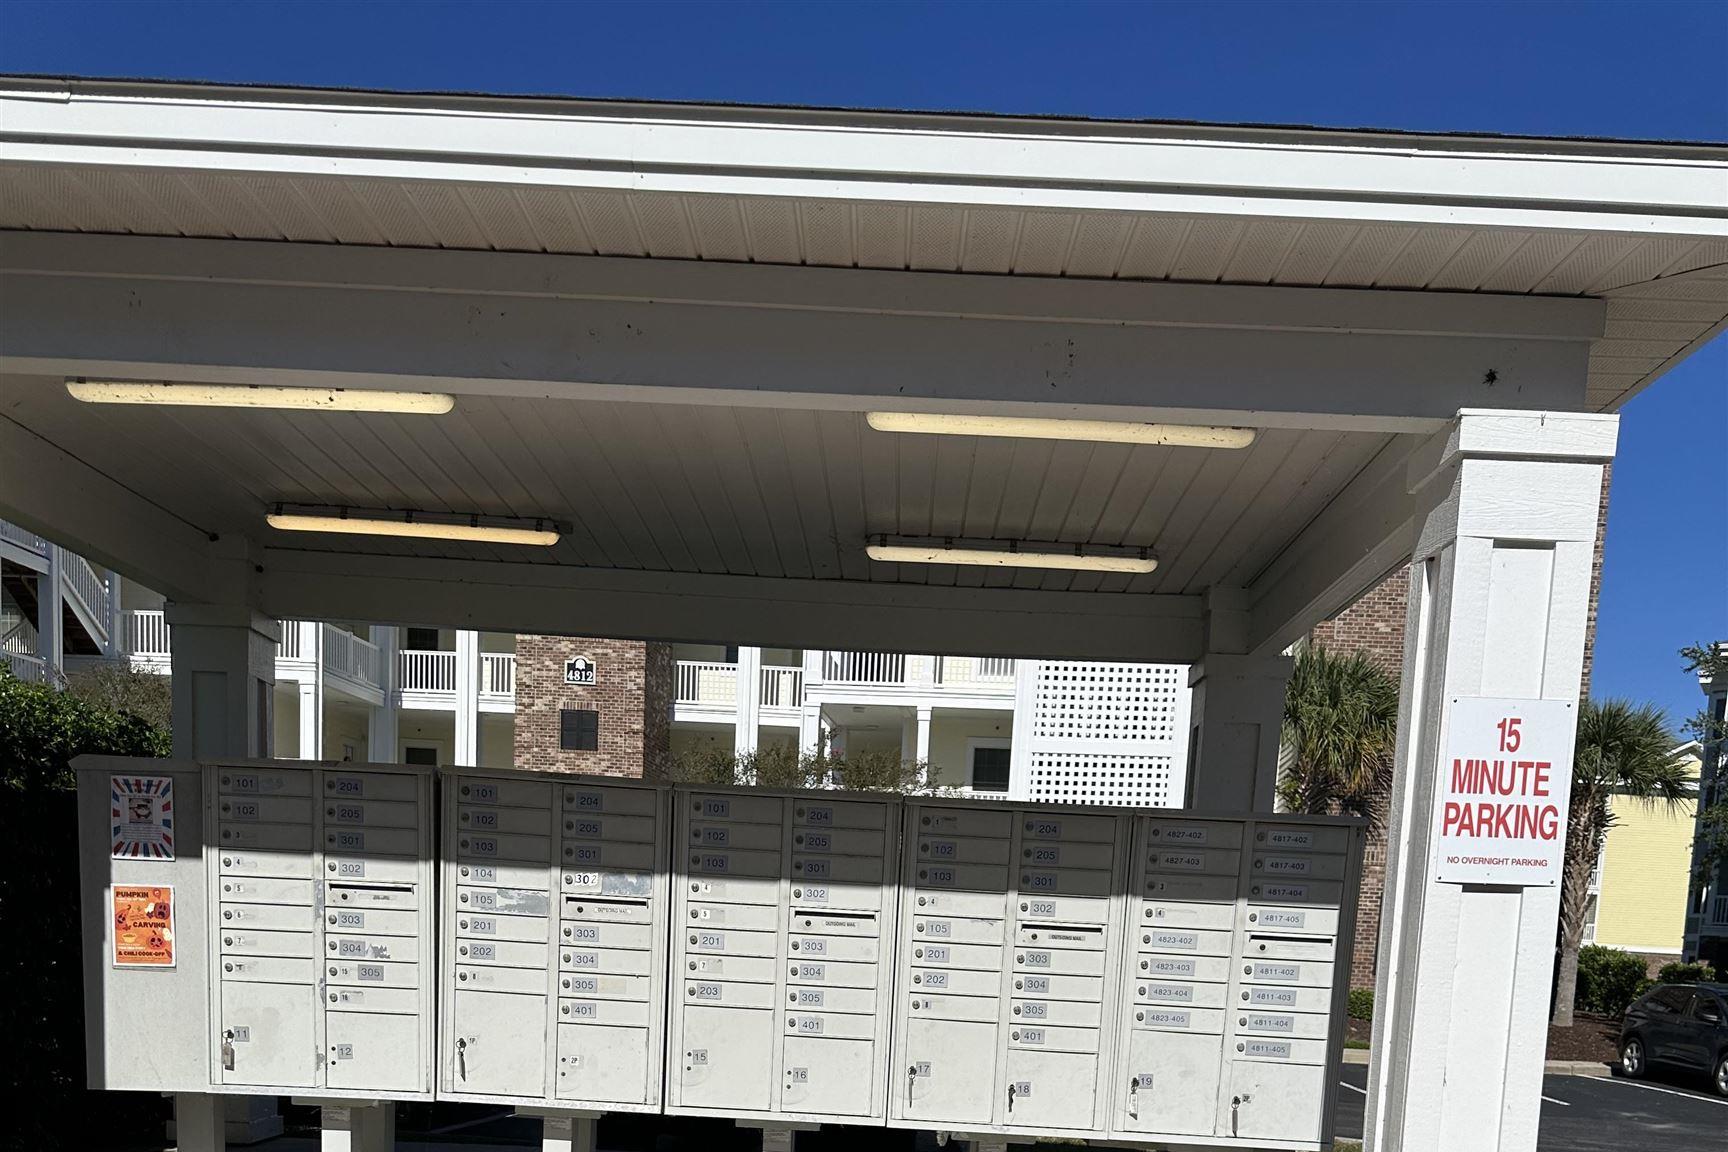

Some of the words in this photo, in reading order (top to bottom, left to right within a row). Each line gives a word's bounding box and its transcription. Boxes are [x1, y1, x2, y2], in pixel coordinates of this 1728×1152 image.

[568, 670, 593, 681] 4812
[1497, 718, 1522, 752] 15
[1451, 759, 1551, 796] MINUTE
[236, 778, 253, 788] 101
[340, 782, 359, 792] 204
[476, 789, 493, 797] 101
[580, 796, 598, 806] 204
[237, 806, 255, 816] 102
[708, 804, 725, 813] 101
[340, 809, 359, 818] 205
[810, 811, 828, 820] 204
[475, 816, 494, 824] 102
[1442, 802, 1558, 840] PARKING
[579, 824, 598, 832] 205
[1039, 825, 1057, 834] 204
[707, 832, 725, 840] 102
[1167, 831, 1201, 839] 4827-402
[1272, 835, 1308, 844] 4817-402
[342, 836, 359, 845] 301
[808, 838, 827, 847] 205
[475, 842, 494, 851] 103
[935, 846, 952, 854] 102
[578, 849, 597, 859] 301
[1037, 851, 1055, 860] 205
[706, 858, 724, 867] 103
[1165, 857, 1200, 866] 4827-403
[1270, 862, 1305, 870] 4817-403
[1447, 856, 1460, 864] NO
[1462, 857, 1509, 865] OVERNIGHT
[1511, 859, 1548, 867] PARKING
[342, 864, 360, 873] 302
[807, 864, 825, 872] 301
[475, 869, 492, 878] 104
[934, 872, 952, 881] 103
[575, 874, 597, 885] 302
[1035, 877, 1052, 886] 301
[807, 889, 825, 898] 302
[1267, 888, 1302, 896] 4817-404
[475, 896, 492, 904] 105
[1034, 904, 1052, 912] 302
[342, 915, 360, 924] 303
[1264, 914, 1299, 923] 4817-405
[473, 922, 491, 930] 201
[930, 925, 947, 933] 105
[576, 929, 595, 938] 303
[702, 936, 720, 945] 201
[1158, 936, 1192, 944] 4823-402
[342, 943, 361, 952] 304
[805, 942, 823, 950] 303
[473, 947, 491, 956] 202
[928, 950, 945, 958] 201
[576, 956, 594, 964] 304
[1029, 955, 1047, 963] 303
[803, 967, 821, 976] 304
[1156, 963, 1190, 971] 4823-403
[361, 968, 380, 976] 305
[1260, 968, 1294, 976] 4811-402
[927, 976, 944, 984] 202
[1027, 980, 1046, 989] 304
[575, 981, 594, 990] 305
[700, 987, 718, 995] 203
[1154, 989, 1187, 997] 4823-404
[802, 994, 820, 1002] 305
[1256, 994, 1291, 1002] 4811-403
[574, 1006, 592, 1015] 401
[1025, 1006, 1043, 1014] 305
[1151, 1015, 1185, 1023] 4823-405
[1254, 1019, 1288, 1027] 4811-404
[803, 1021, 820, 1030] 401
[236, 1029, 248, 1039] 11
[1024, 1032, 1041, 1041] 401
[340, 1047, 351, 1056] 12
[1251, 1045, 1286, 1053] 4811-405
[695, 1053, 706, 1061] 15
[919, 1065, 929, 1073] 17
[795, 1071, 806, 1079] 16
[1141, 1077, 1152, 1085] 19
[1019, 1085, 1029, 1094] 18
